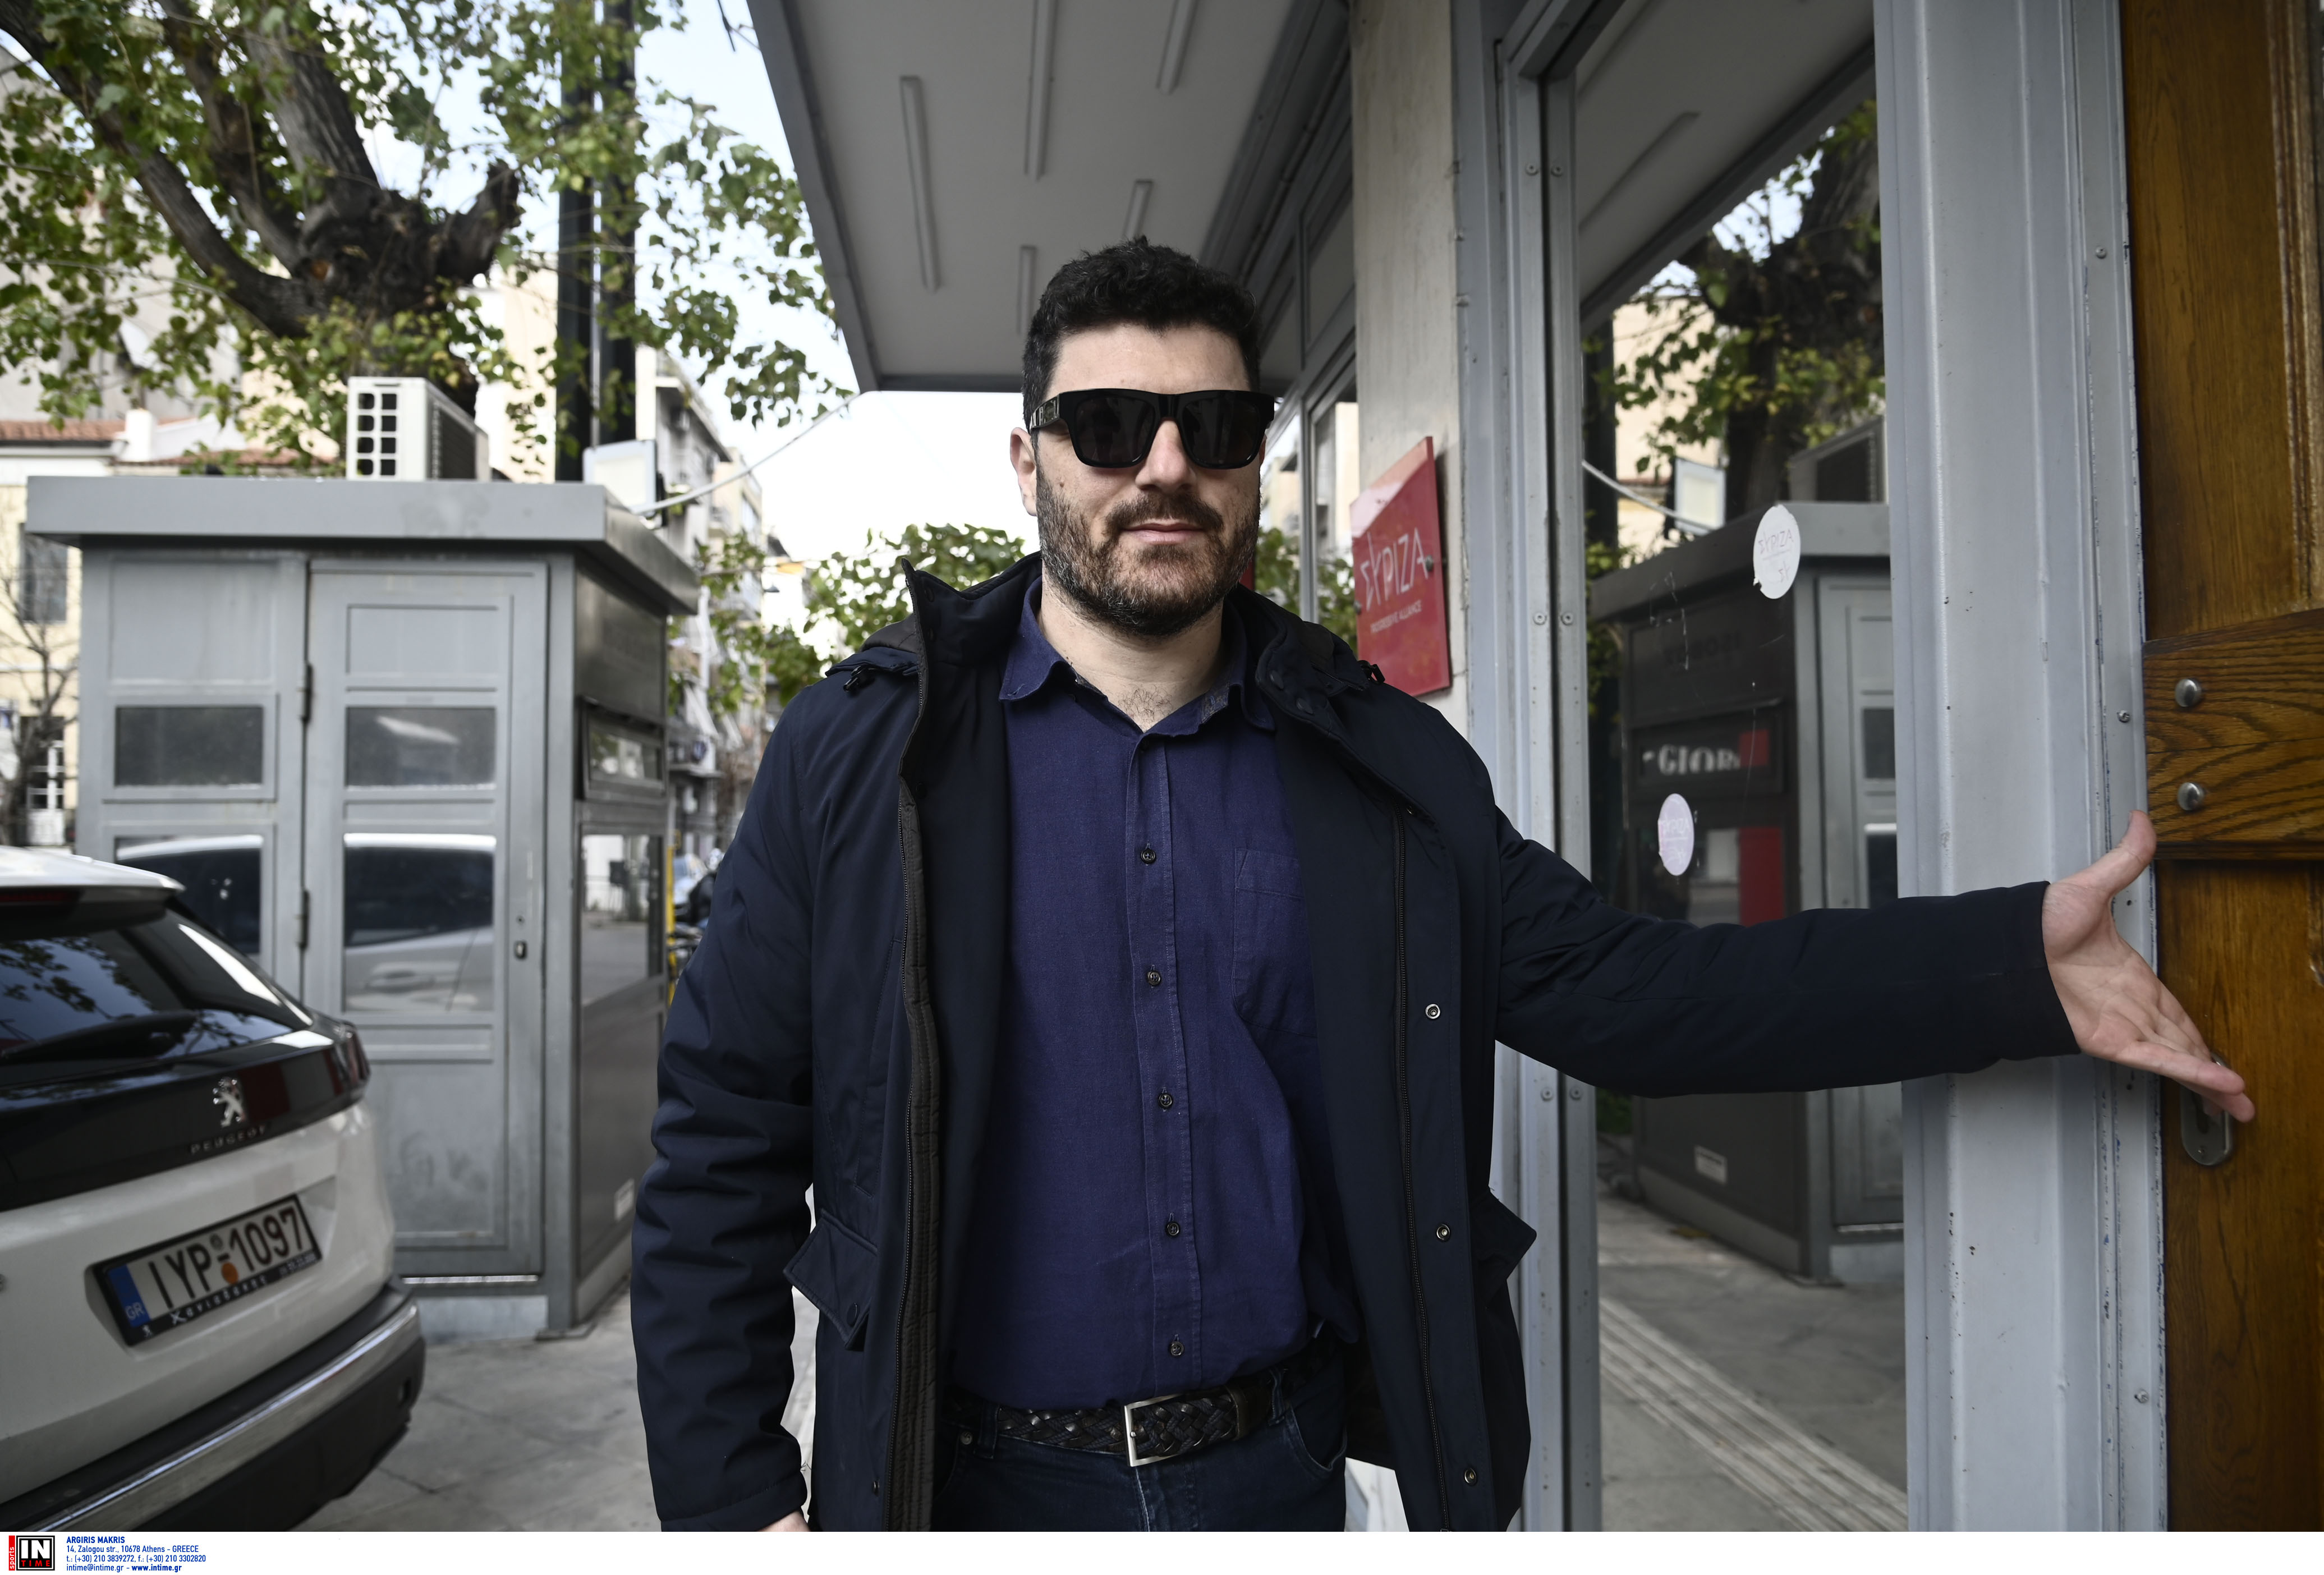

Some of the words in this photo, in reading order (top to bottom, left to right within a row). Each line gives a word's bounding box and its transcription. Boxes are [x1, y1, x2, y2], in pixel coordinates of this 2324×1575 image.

[1399, 599, 1422, 619] ALLIANCE
[191, 1124, 265, 1155] PEUGEOT
[125, 1301, 145, 1320] GR
